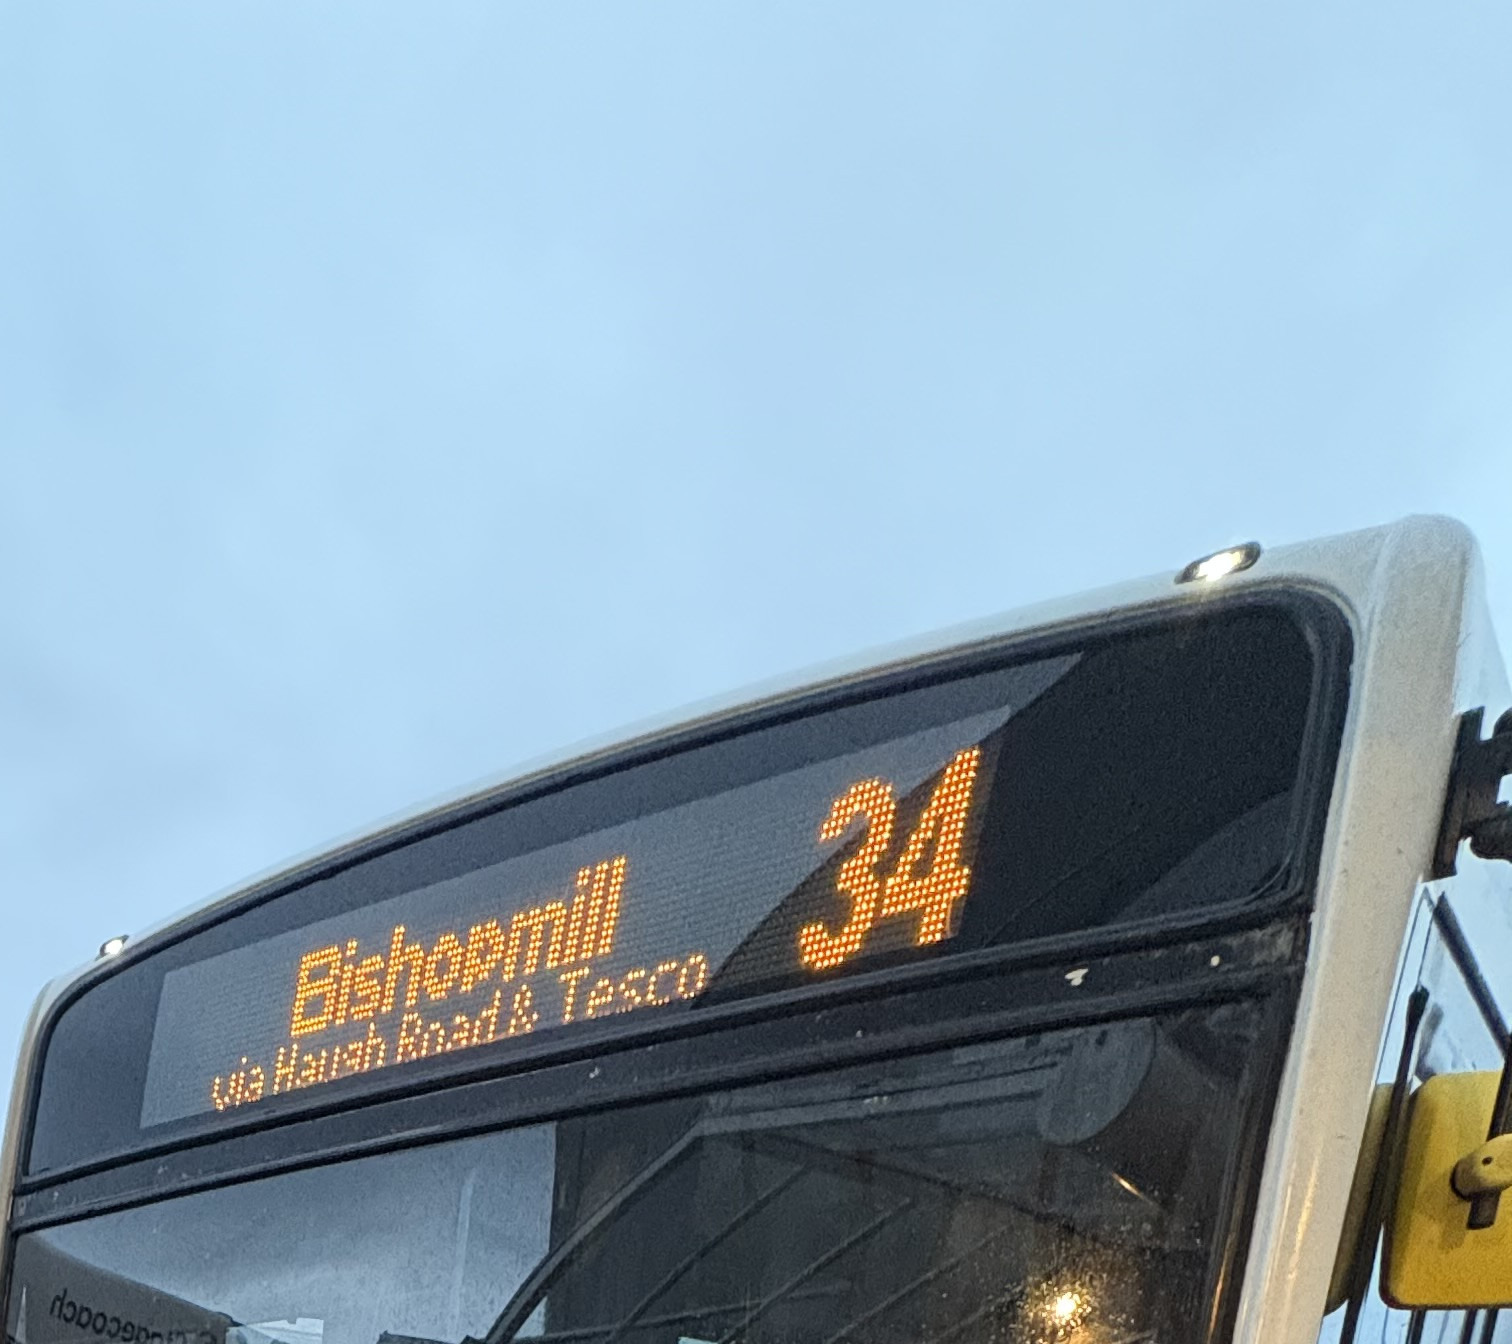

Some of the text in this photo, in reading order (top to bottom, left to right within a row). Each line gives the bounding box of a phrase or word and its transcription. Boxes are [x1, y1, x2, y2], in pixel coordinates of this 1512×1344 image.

[289, 856, 629, 1038] Bishopmill
[799, 745, 982, 972] 34
[211, 1058, 264, 1112] via
[395, 988, 501, 1063] Road
[510, 985, 539, 1034] &
[557, 953, 709, 1025] Tesco
